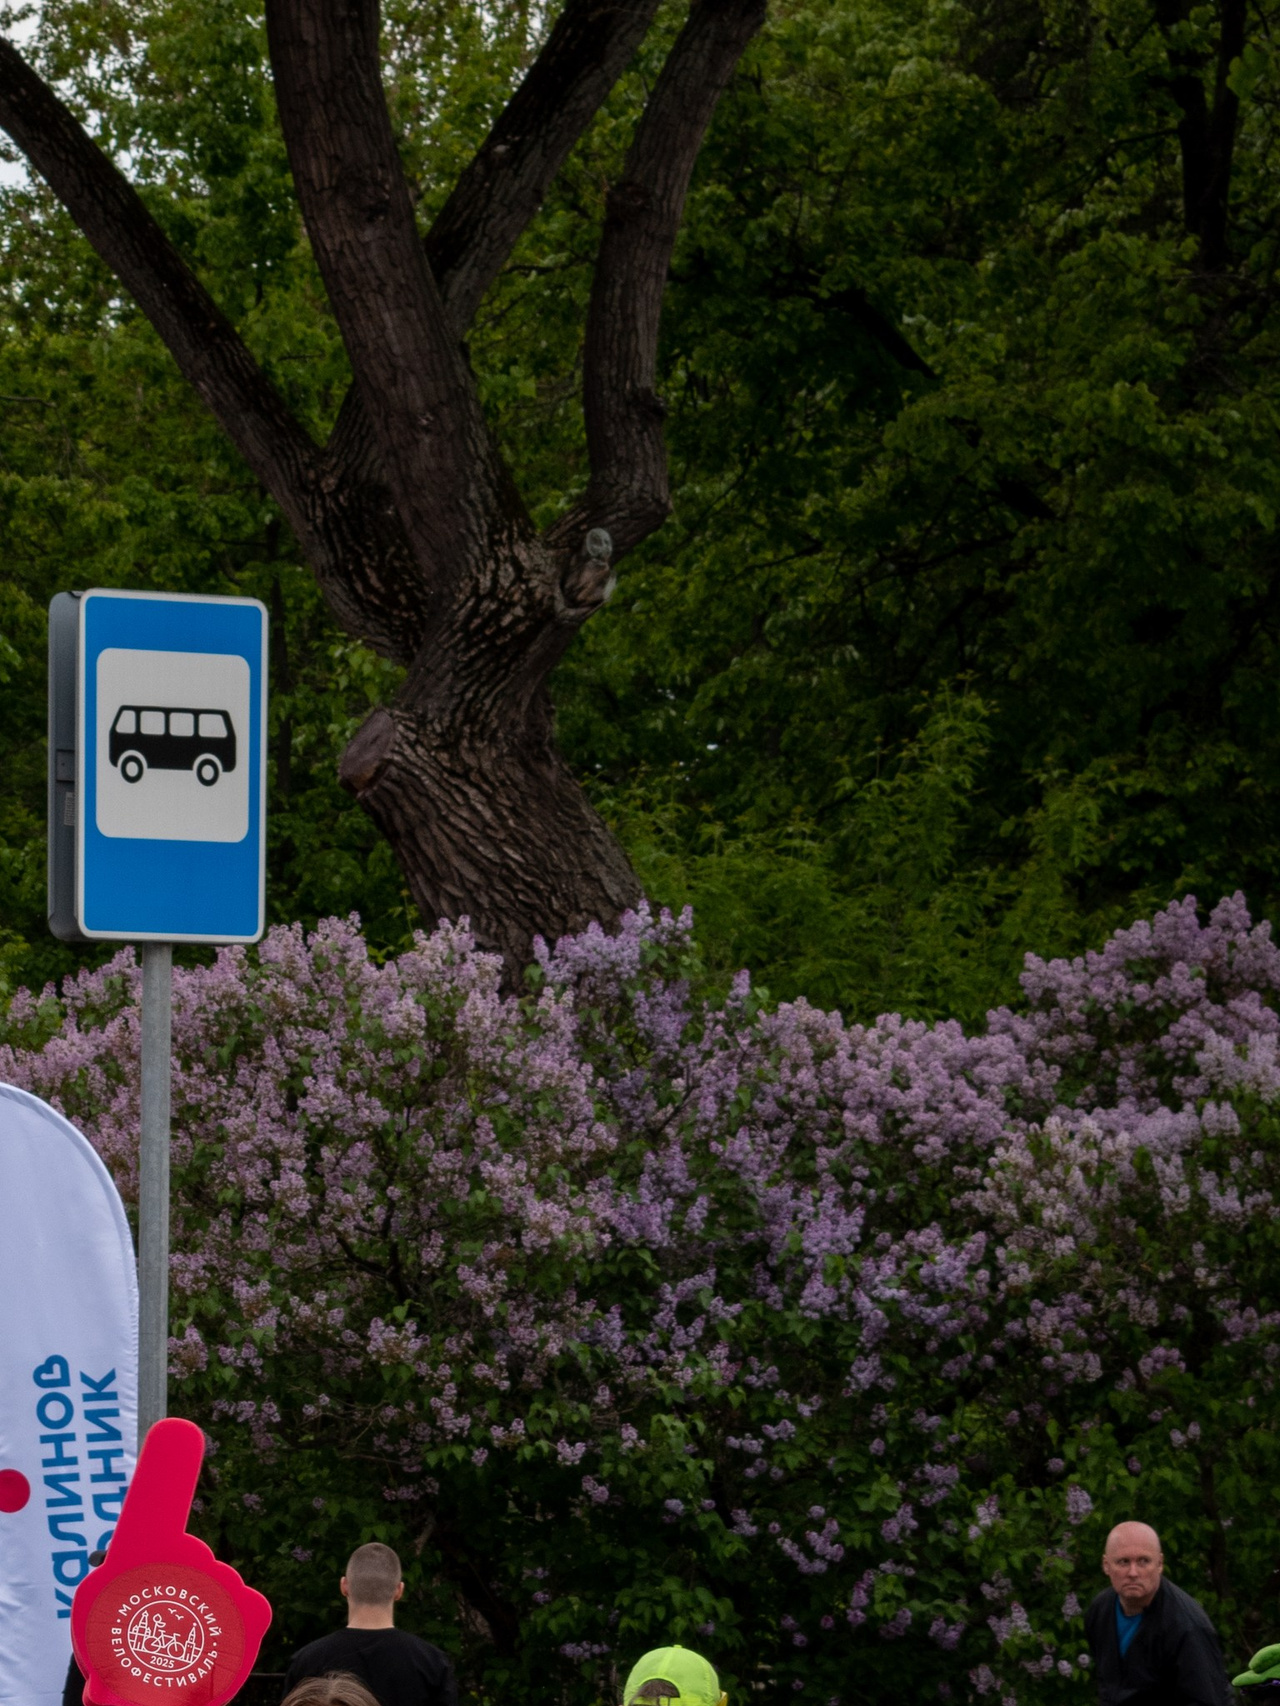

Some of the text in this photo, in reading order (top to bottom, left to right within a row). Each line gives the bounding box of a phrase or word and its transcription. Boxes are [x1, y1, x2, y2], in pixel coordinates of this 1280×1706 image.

[118, 1586, 222, 1637] МОСКОВСКИЙ
[111, 1627, 218, 1688] ВЕЛОФЕСТИВАЛЬ
[150, 1655, 175, 1669] 2025
